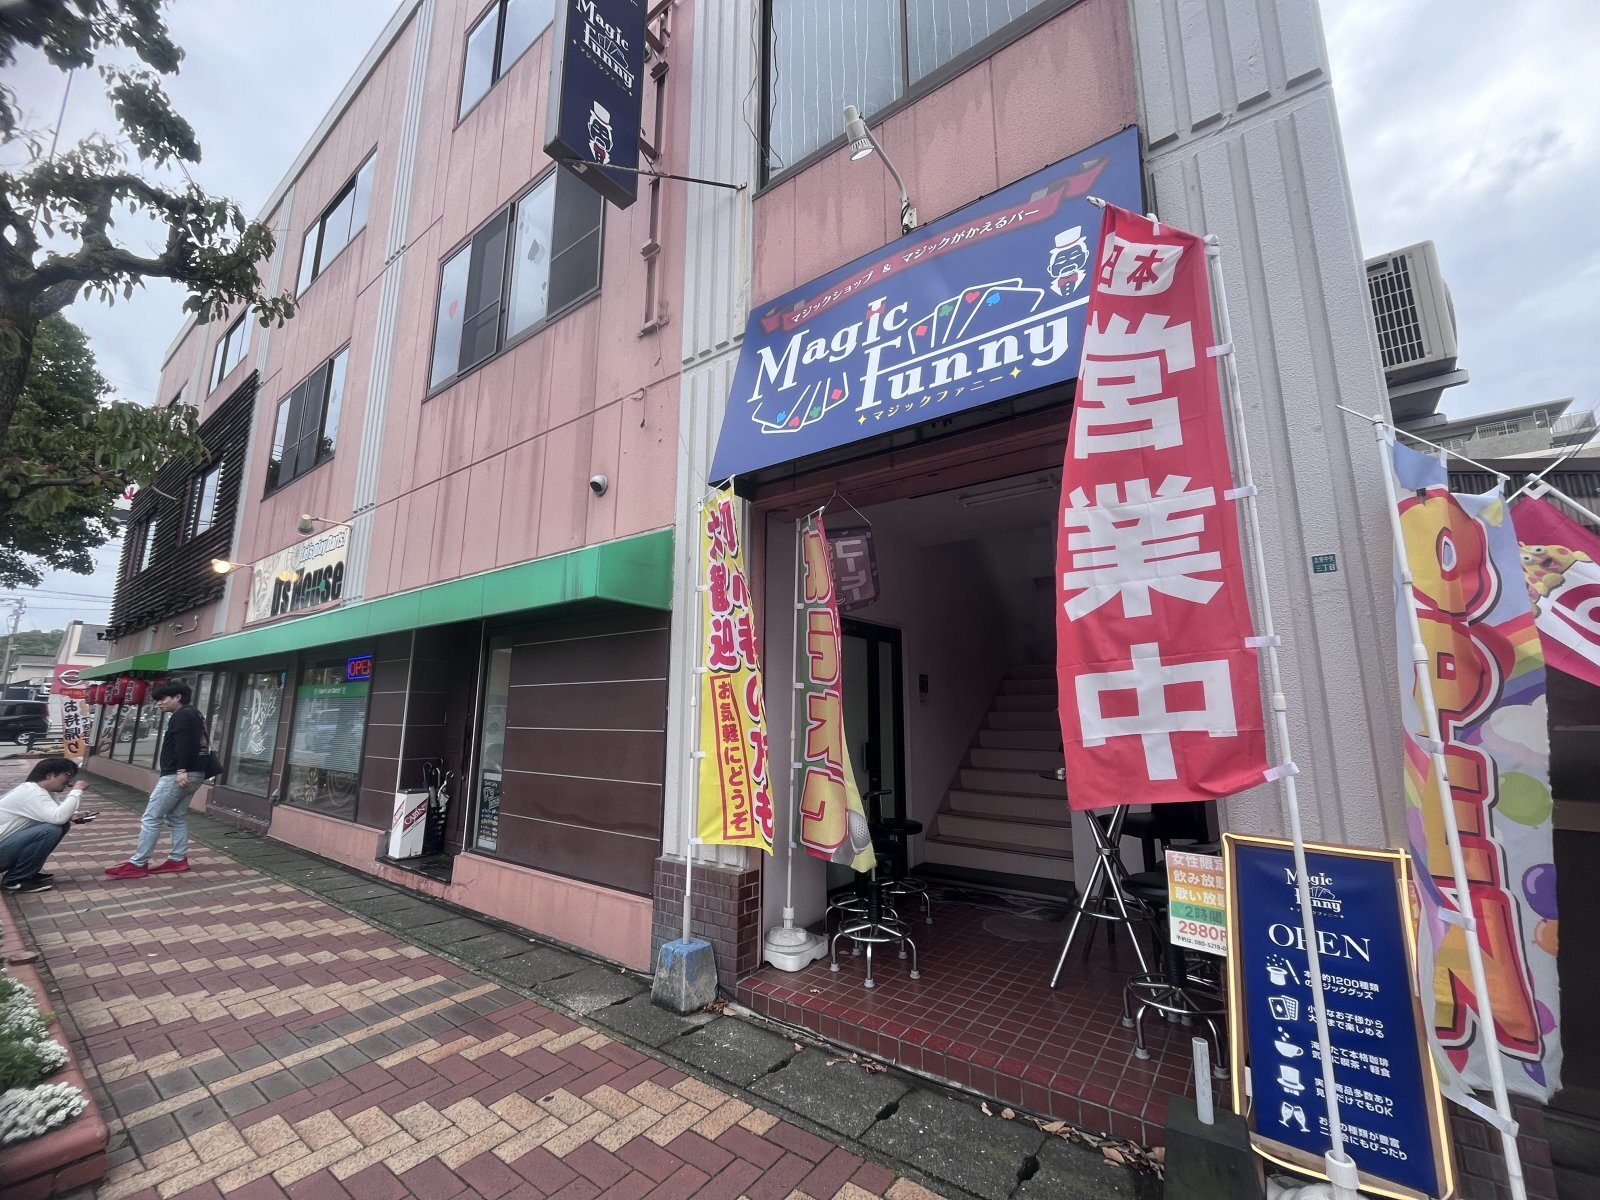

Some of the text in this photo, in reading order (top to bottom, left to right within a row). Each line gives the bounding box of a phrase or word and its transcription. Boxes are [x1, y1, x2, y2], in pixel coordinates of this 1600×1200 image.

[576, 0, 629, 51] Magic
[583, 20, 635, 89] Funny
[791, 208, 1040, 323] マジックショップ & マジックがかえるバー
[747, 296, 909, 403] Magic
[855, 316, 1069, 413] Funny
[873, 376, 1003, 421] マジックファニー
[718, 680, 749, 832] お気軽にどうぞ
[405, 804, 426, 825] CABIN
[1284, 867, 1333, 886] Mgic
[1185, 905, 1222, 923] 2時間
[1303, 970, 1380, 992] 本的1200種類
[1304, 980, 1374, 1000] のジックグッズ
[1307, 1004, 1384, 1029] 小なお子様から
[1308, 1014, 1385, 1039] 大まで楽しめる
[1311, 1040, 1389, 1068] 淹たて本格珈琲
[1312, 1050, 1391, 1079] 気に喫茶・軽食
[1314, 1077, 1394, 1106] 実商品多数あり
[1316, 1087, 1394, 1118] 見だけでもOK
[1319, 1116, 1400, 1149] おの種類が豊富
[1320, 1126, 1408, 1161] 二会にもぴったり
